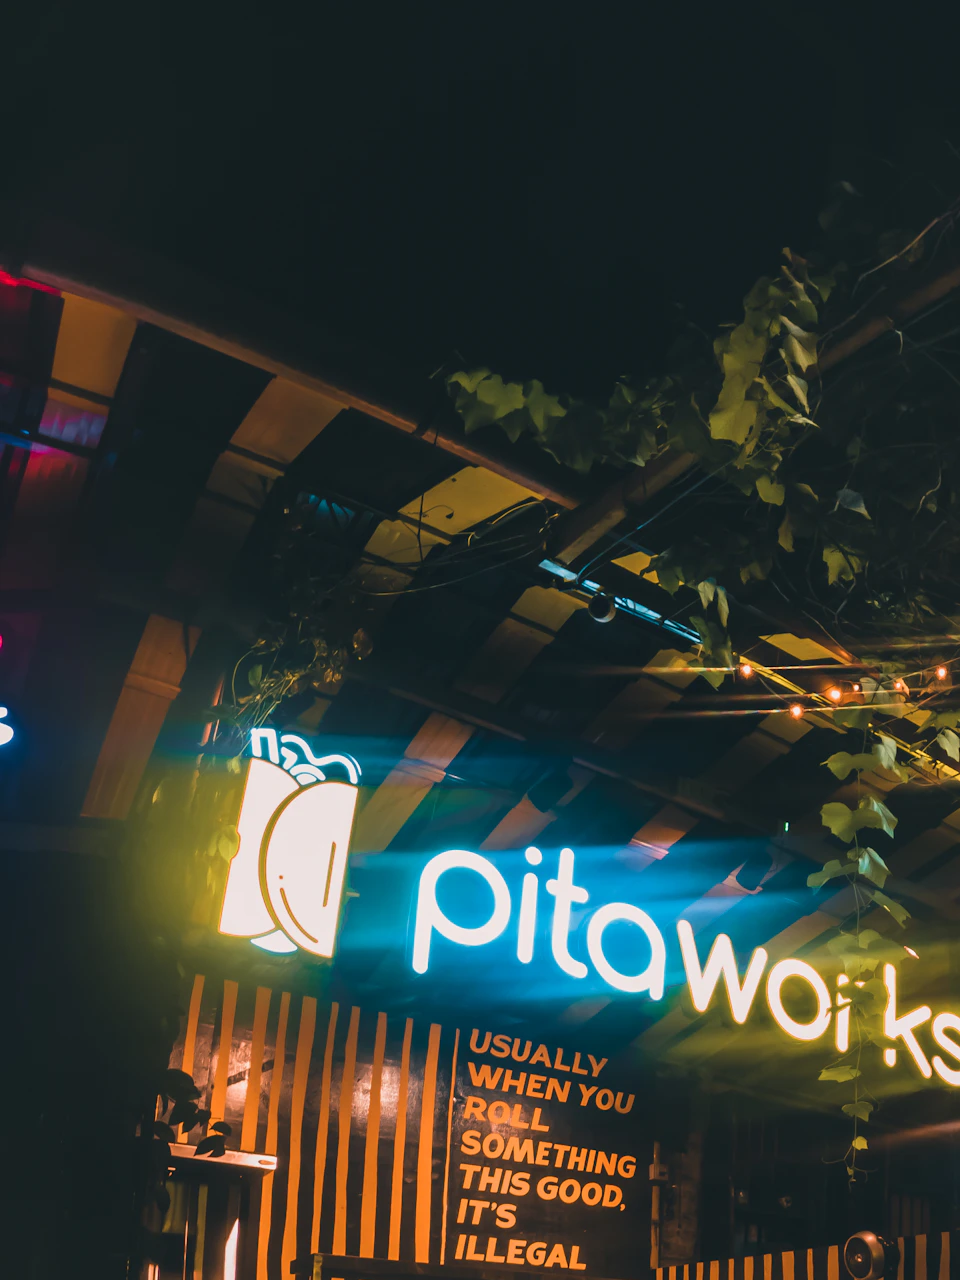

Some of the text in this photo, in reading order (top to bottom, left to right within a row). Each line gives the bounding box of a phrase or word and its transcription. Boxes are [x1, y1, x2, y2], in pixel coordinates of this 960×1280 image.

[469, 1028, 608, 1077] USUALLY
[467, 1061, 635, 1114] WHEN YOU
[463, 1095, 550, 1132] ROLL
[460, 1129, 637, 1179] SOMETHING
[459, 1164, 626, 1211] THIS GOOD,
[456, 1198, 517, 1228] IT'S
[454, 1234, 587, 1271] ILLEGAL
